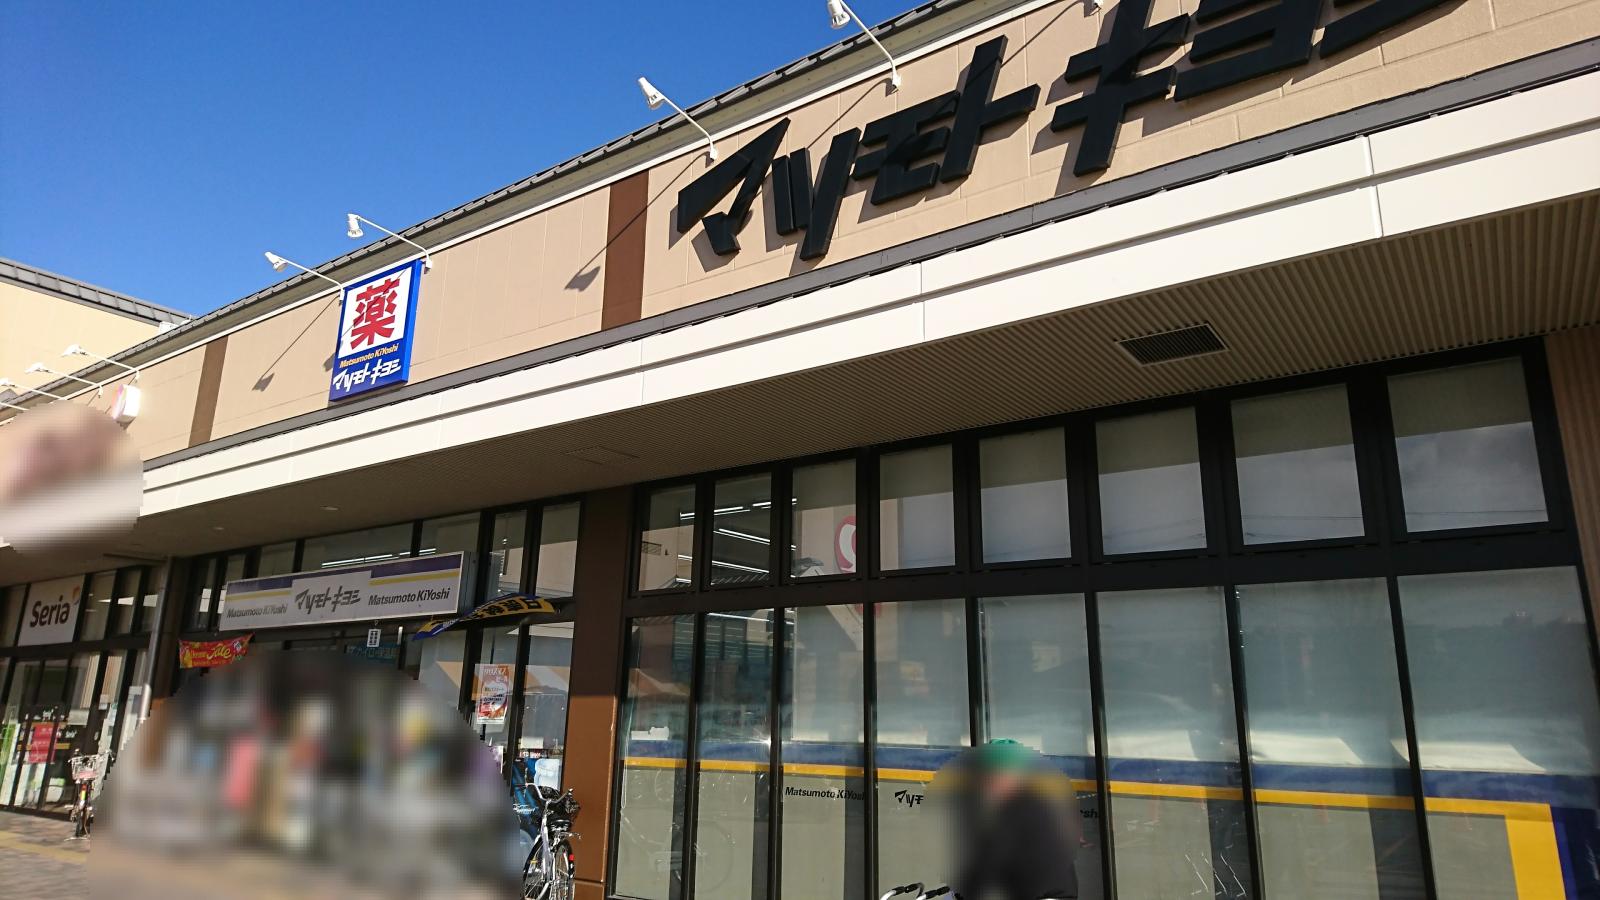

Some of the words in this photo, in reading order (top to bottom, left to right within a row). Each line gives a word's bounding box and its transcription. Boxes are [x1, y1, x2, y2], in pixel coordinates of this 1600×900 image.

[349, 278, 401, 350] 薬
[340, 351, 375, 368] Matsumoto
[374, 343, 400, 358] KiYoshi
[332, 358, 402, 392] マツモトキヨシ
[295, 585, 361, 614] マツモトキヨシ
[368, 592, 416, 606] Matsumoto
[416, 587, 450, 603] KiYoshi
[30, 597, 71, 628] Seria
[226, 605, 263, 619] Matsumoto
[785, 786, 836, 799] Matsumoto
